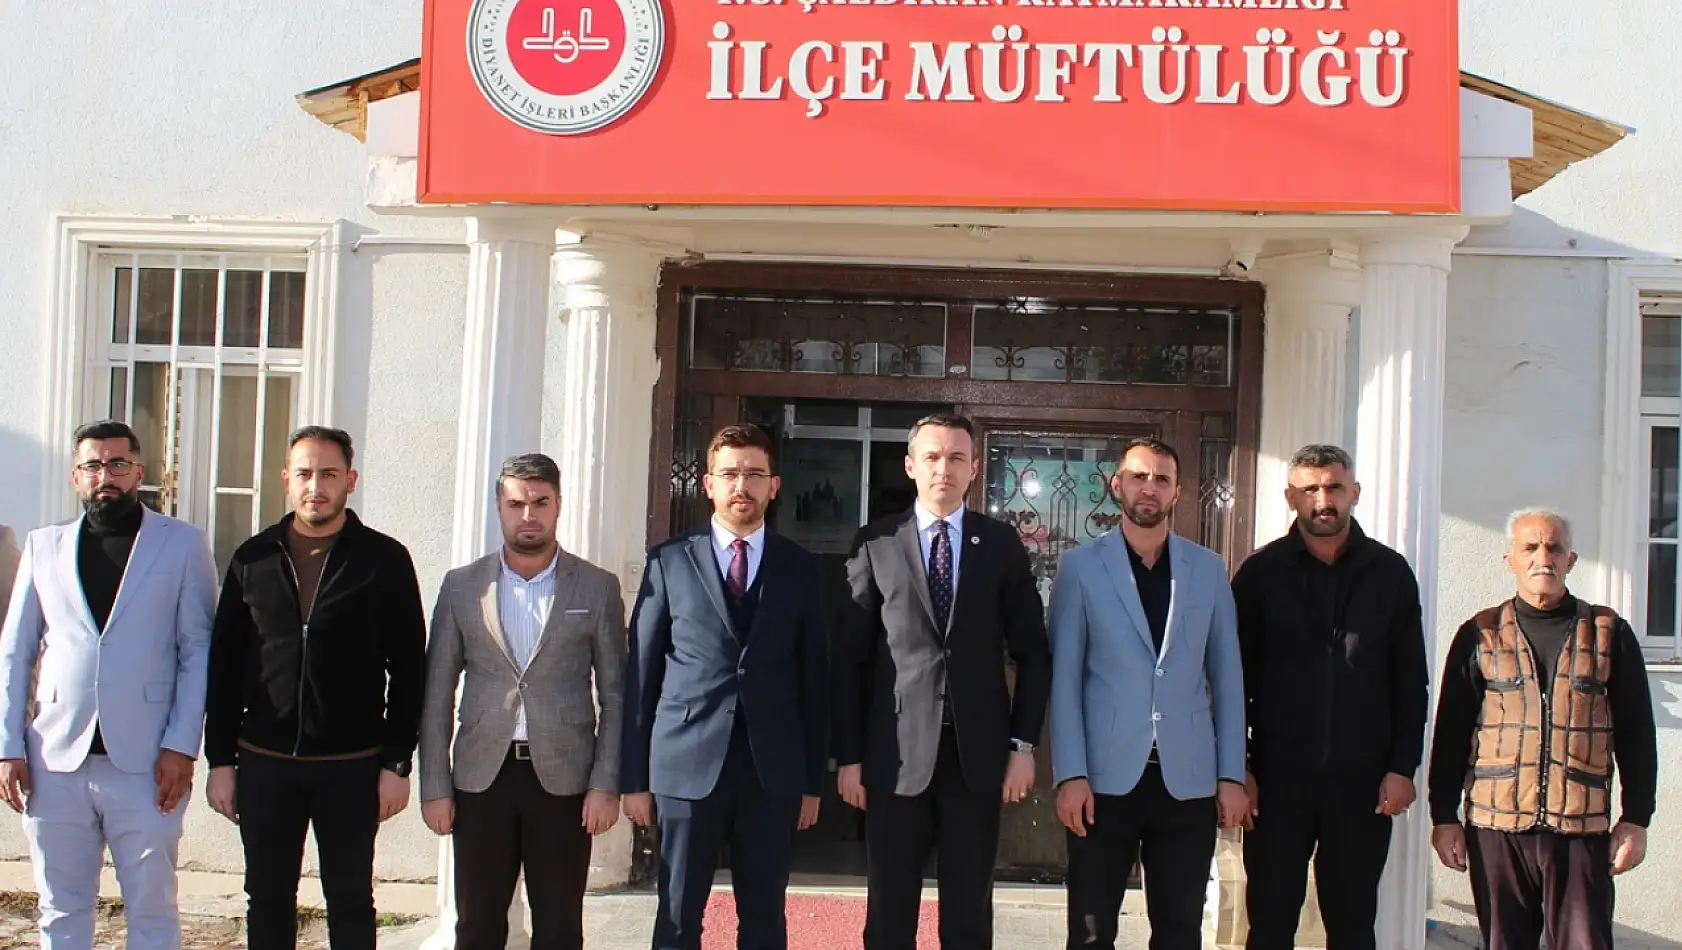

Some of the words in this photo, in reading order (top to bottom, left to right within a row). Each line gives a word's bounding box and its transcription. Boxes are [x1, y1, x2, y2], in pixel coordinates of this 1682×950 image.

[481, 37, 520, 102] DİYANET
[519, 96, 574, 120] İŞLERİ
[579, 38, 650, 117] BAŞKANLIĞI
[706, 21, 886, 117] İLÇE
[904, 24, 1408, 107] MÜFTÜLÜĞÜ
